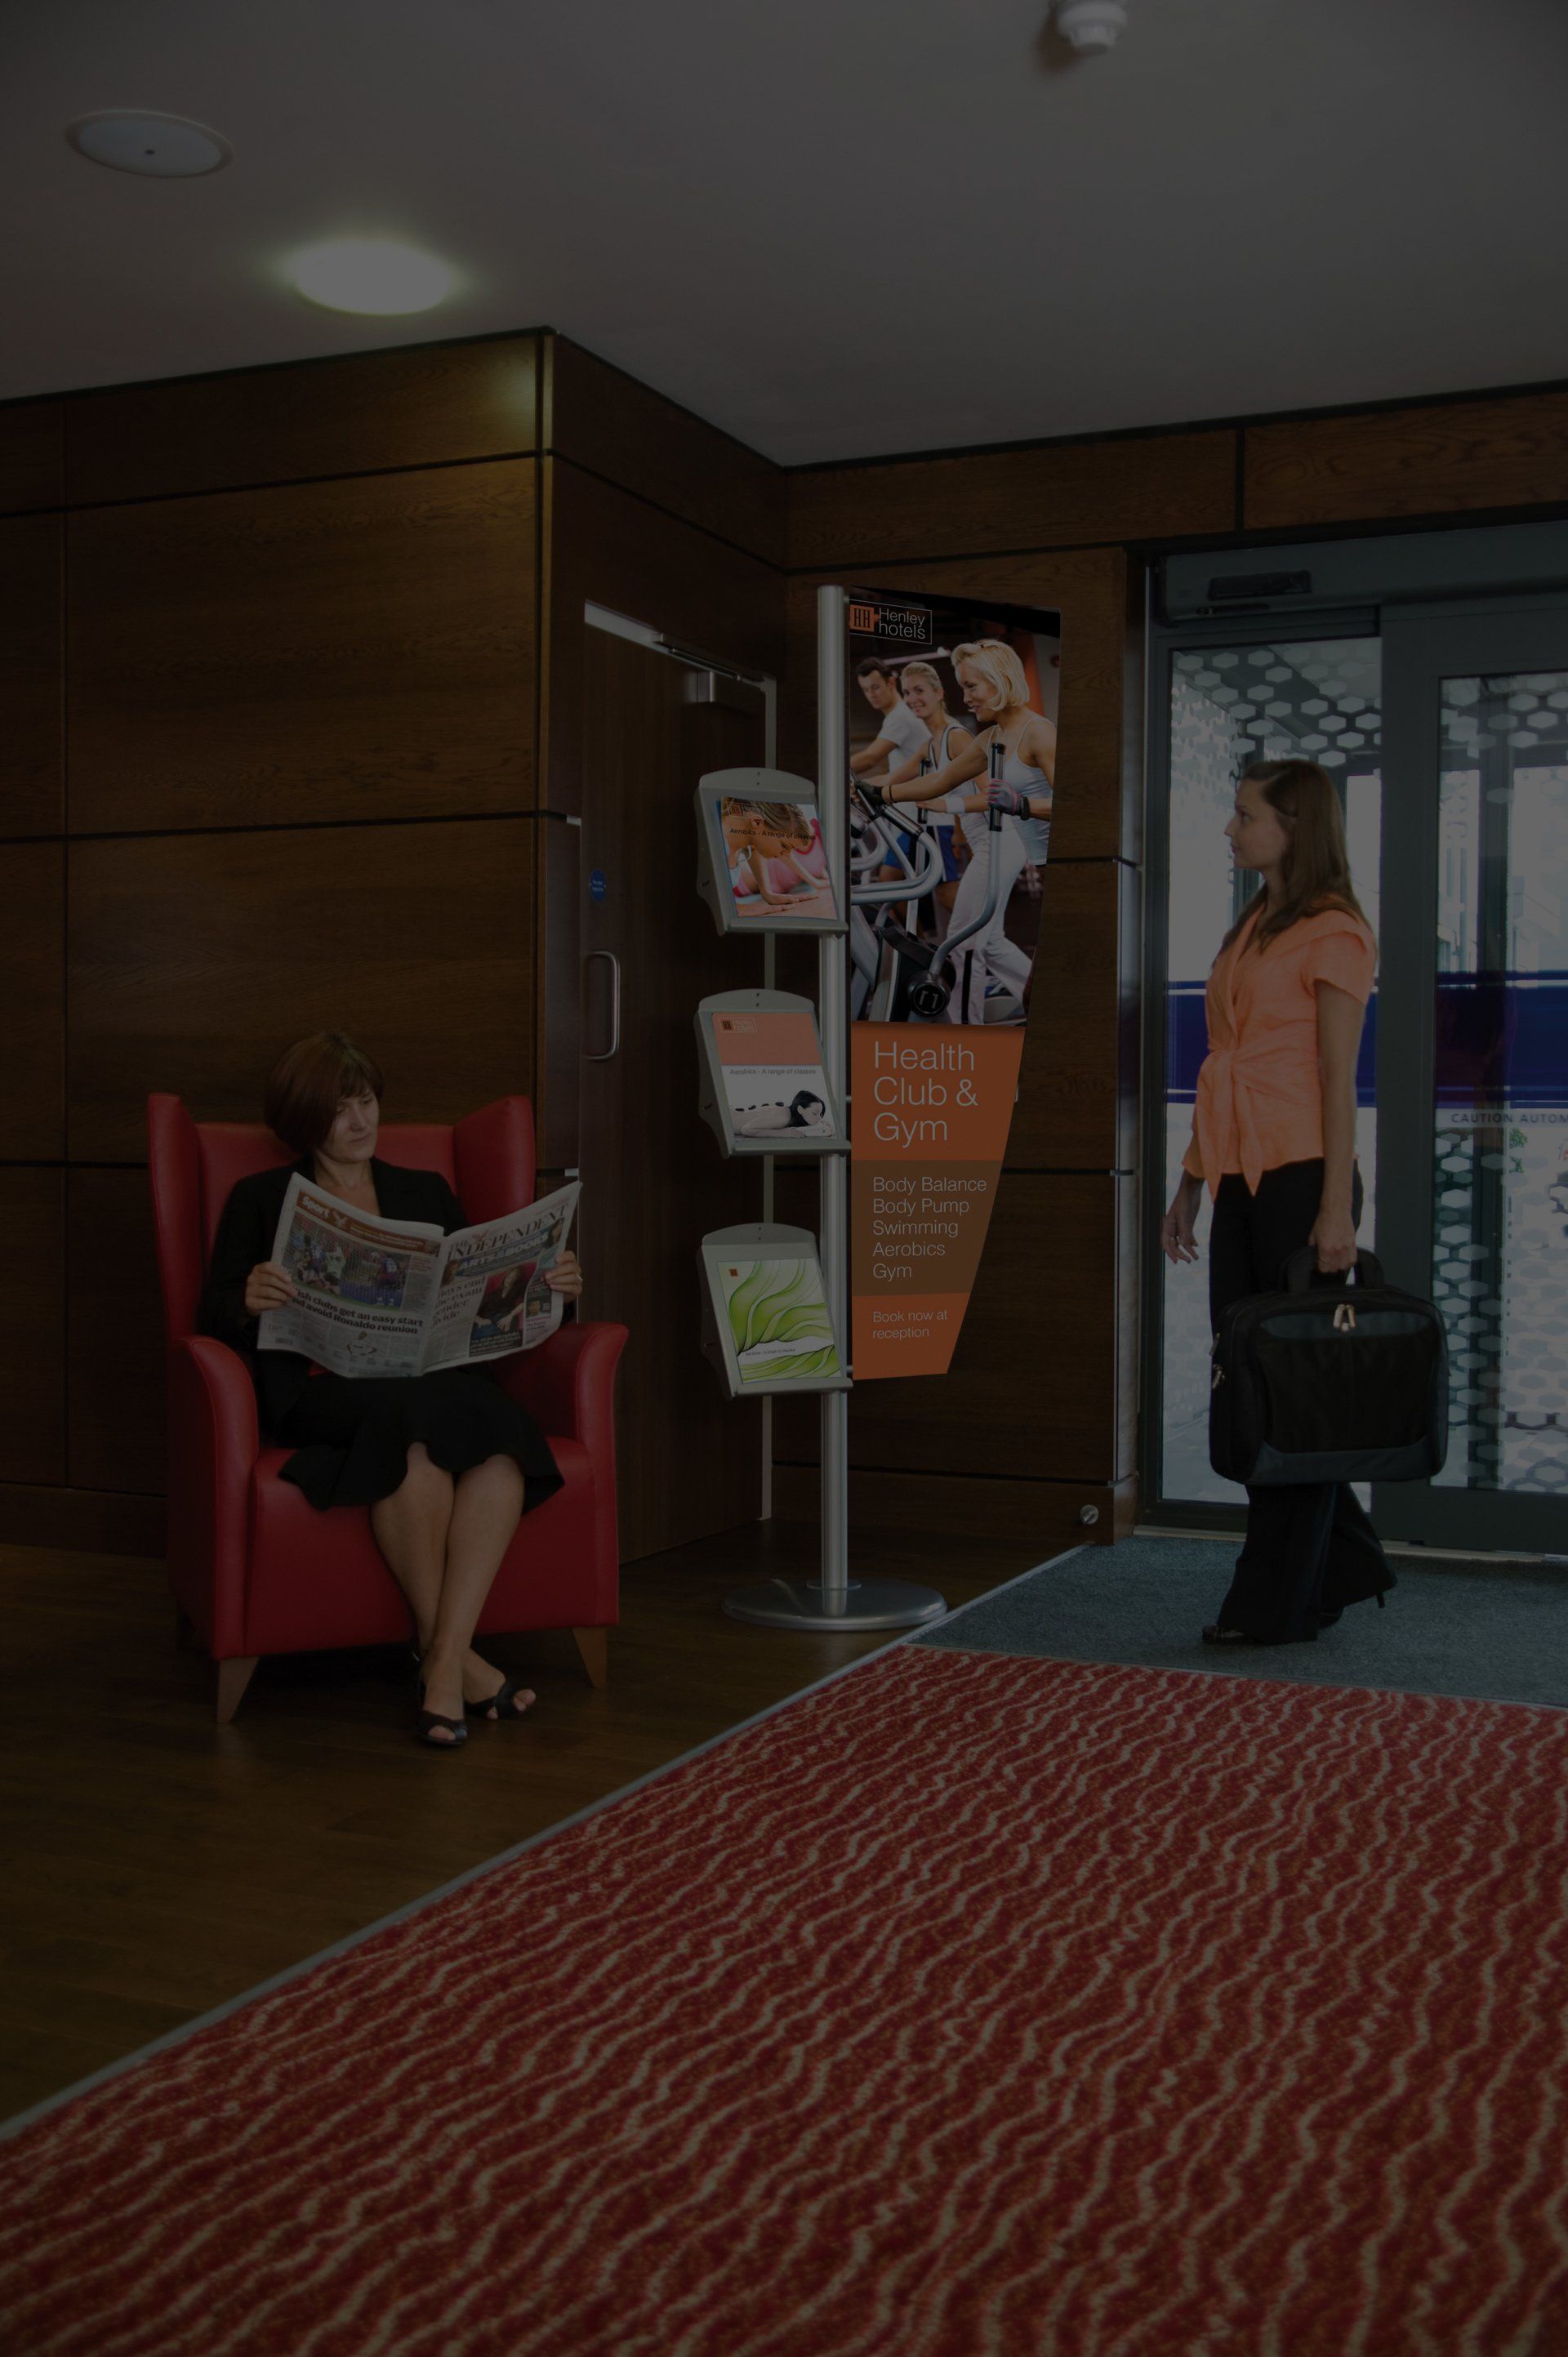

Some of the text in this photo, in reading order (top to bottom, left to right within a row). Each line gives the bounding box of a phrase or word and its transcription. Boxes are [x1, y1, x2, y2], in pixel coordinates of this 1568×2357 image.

[879, 607, 926, 628] Henley
[879, 619, 926, 639] hotels
[730, 827, 756, 835] Aerobics
[875, 1040, 975, 1072] Health
[874, 1076, 978, 1107] Club &
[1450, 1113, 1513, 1123] CAUTION
[874, 1112, 948, 1148] Gym
[873, 1176, 987, 1196] Body Balance
[873, 1198, 970, 1217] Body Pump
[872, 1219, 959, 1238] Swimming
[871, 1241, 946, 1257] Aerobics
[873, 1263, 912, 1282] Gym
[292, 1297, 418, 1334] nd avoid Ronaldo reunion
[313, 1296, 338, 1312] clubs
[339, 1308, 356, 1318] get
[357, 1311, 370, 1321] an
[372, 1315, 397, 1325] easy
[397, 1317, 423, 1327] start
[872, 1309, 948, 1323] Book now at
[872, 1326, 930, 1341] reception
